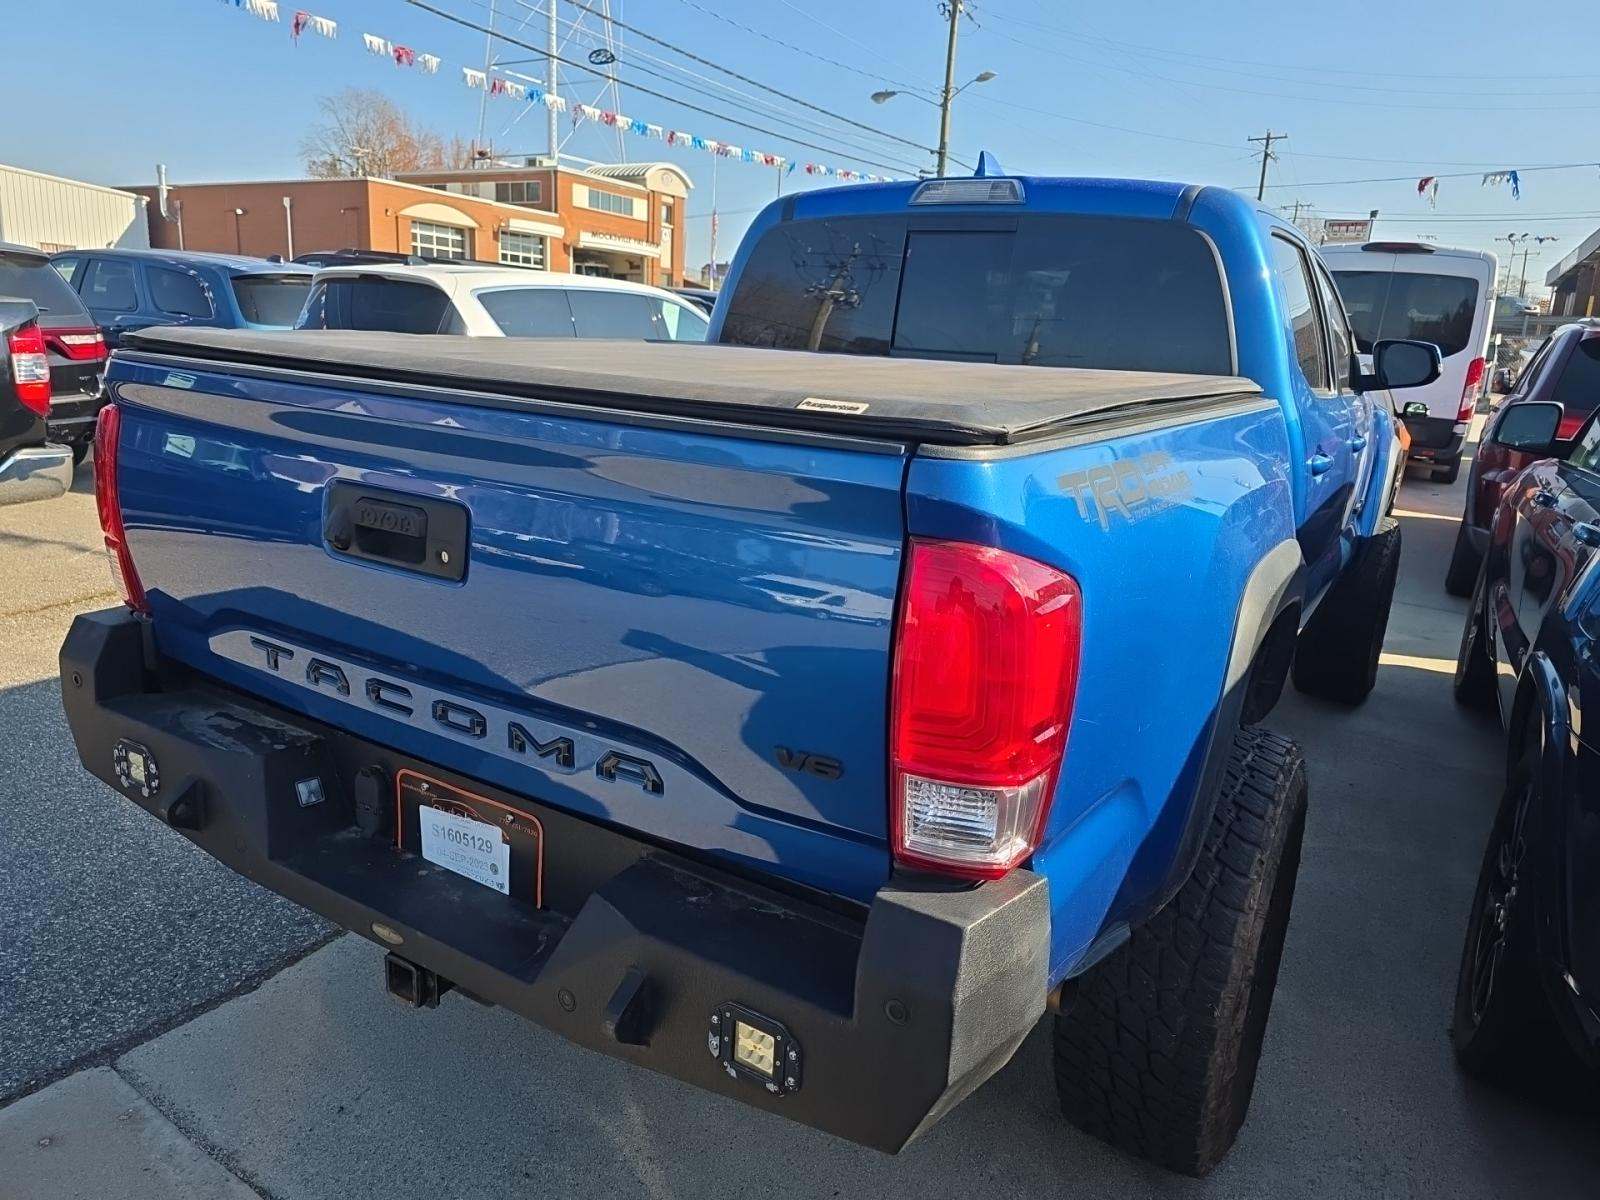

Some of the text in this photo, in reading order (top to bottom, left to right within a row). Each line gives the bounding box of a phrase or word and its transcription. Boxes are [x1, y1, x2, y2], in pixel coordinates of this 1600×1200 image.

[358, 508, 418, 532] TOYOTA
[250, 635, 665, 796] TACOMA
[773, 743, 845, 781] V6
[432, 823, 493, 854] S1605129
